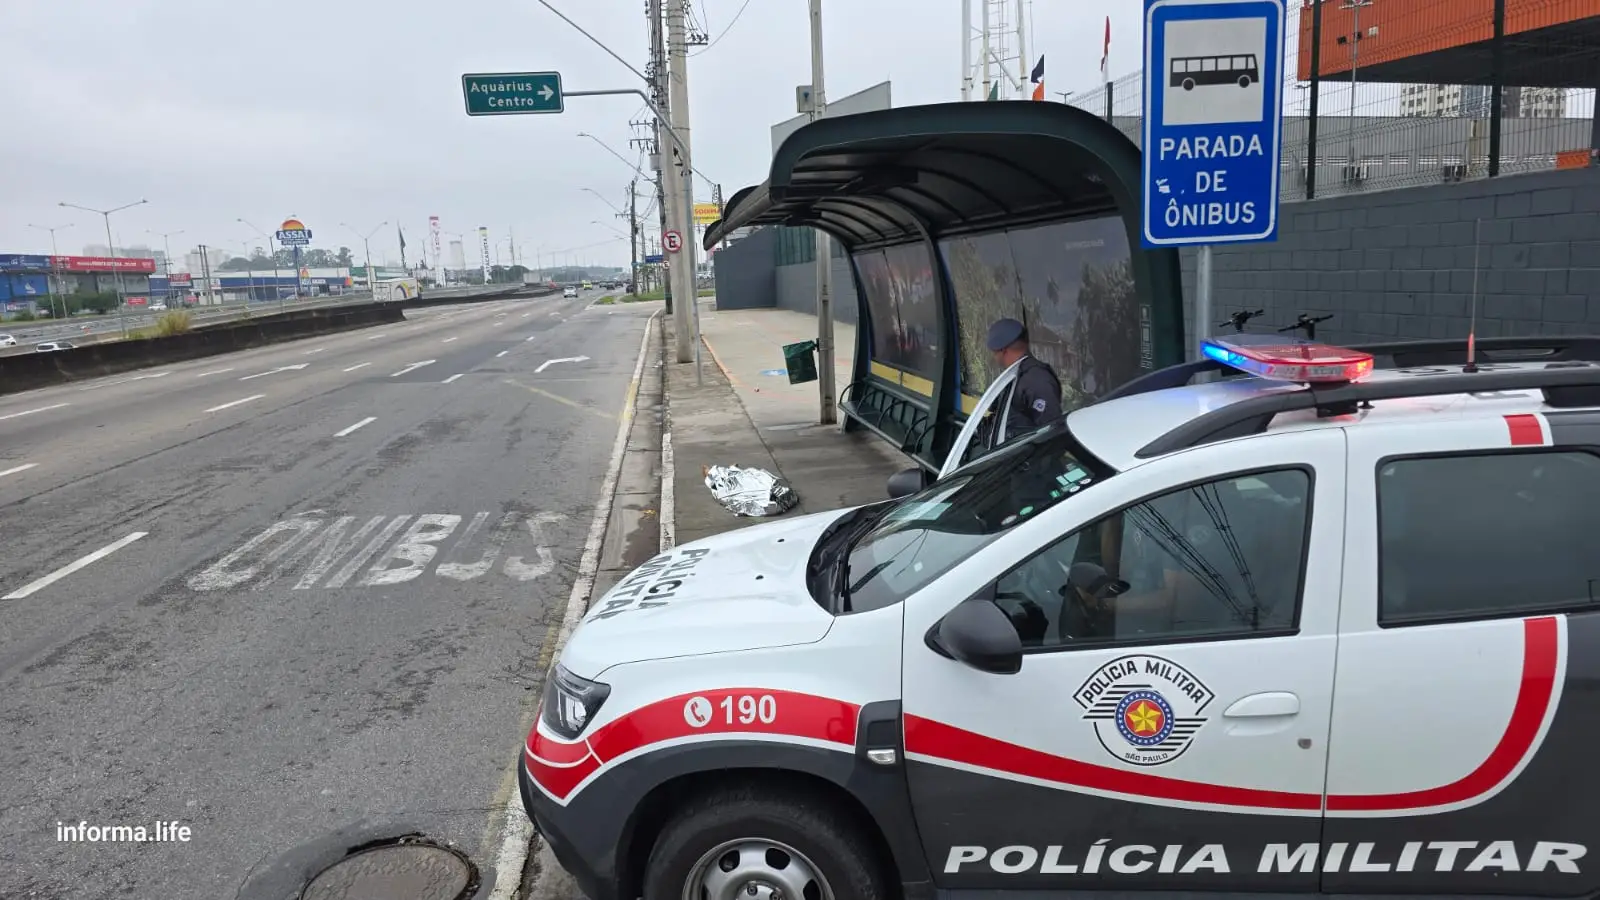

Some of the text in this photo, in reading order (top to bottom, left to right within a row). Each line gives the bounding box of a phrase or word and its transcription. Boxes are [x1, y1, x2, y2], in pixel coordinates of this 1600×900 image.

[470, 80, 532, 94] Aquárius
[488, 96, 534, 107] Centro
[1160, 134, 1263, 161] PARADA
[1195, 170, 1227, 193] DE
[1165, 198, 1256, 227] ÔNIBUS
[184, 508, 568, 591] ÔNIBUS
[586, 556, 673, 624] MILITAR
[638, 548, 710, 609] POLÍCIA
[1082, 660, 1205, 703] POLÍCIA MILITAR
[720, 694, 777, 725] 190
[1125, 752, 1168, 762] SÃO PAULO
[944, 838, 1588, 874] POLÍCIA MILITAR
